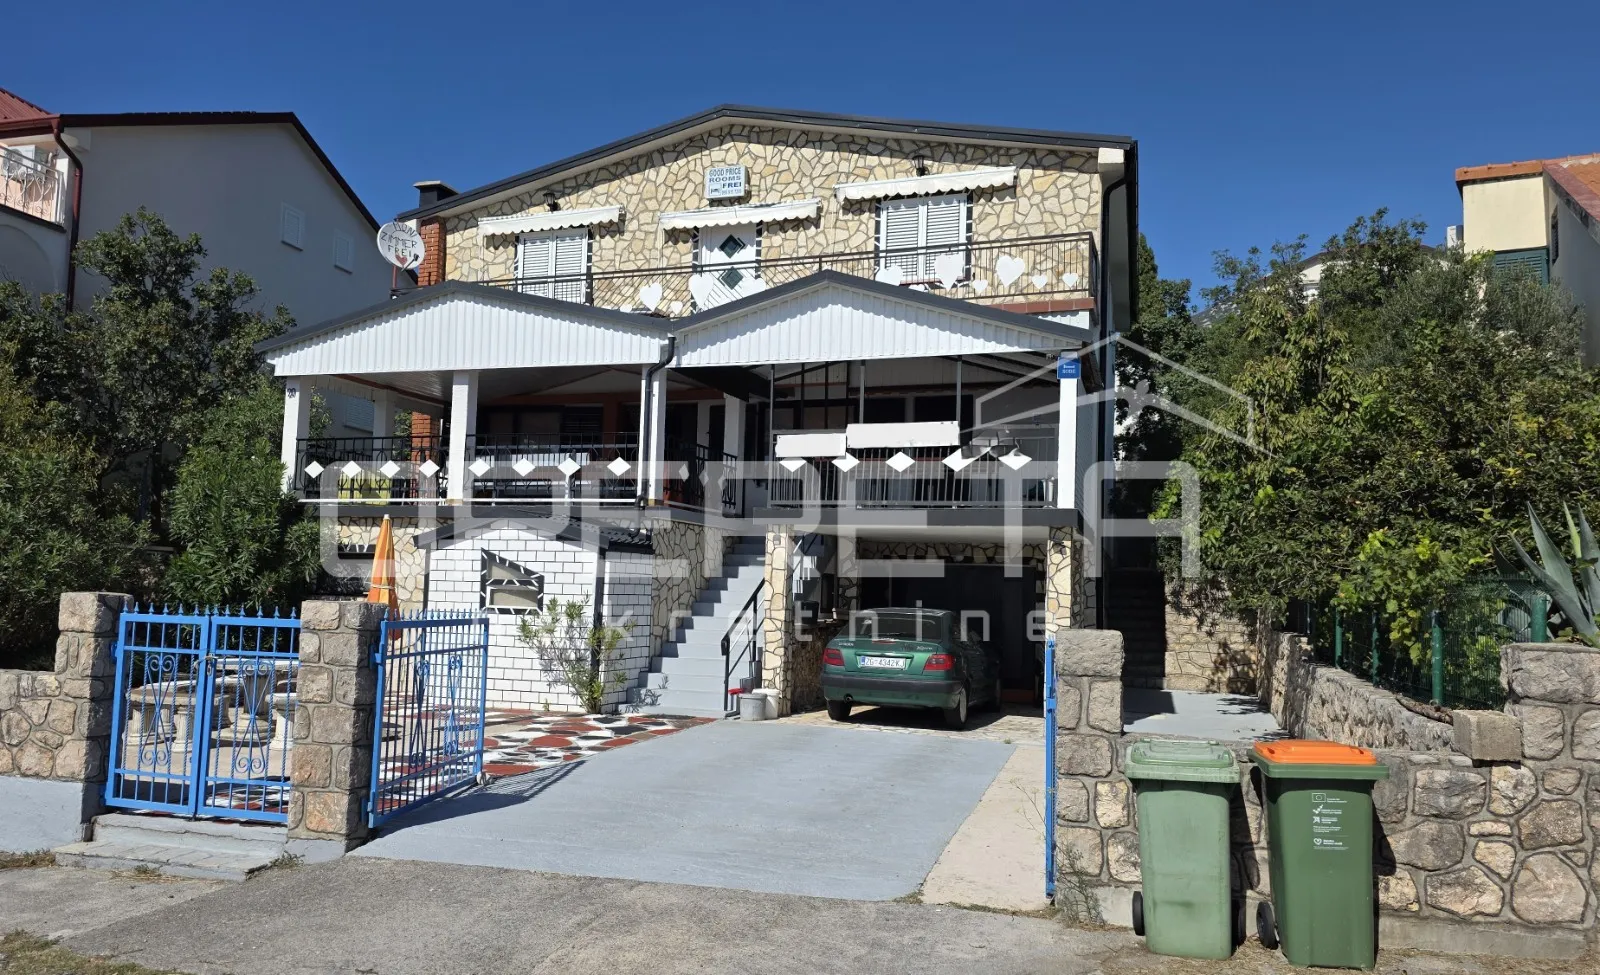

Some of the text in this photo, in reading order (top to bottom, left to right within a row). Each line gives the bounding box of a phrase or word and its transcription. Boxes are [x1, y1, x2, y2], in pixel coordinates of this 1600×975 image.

[709, 167, 742, 177] GOOD PRICE
[709, 175, 742, 183] ROOMS
[380, 231, 418, 249] ZIMMER
[388, 244, 412, 258] FREI
